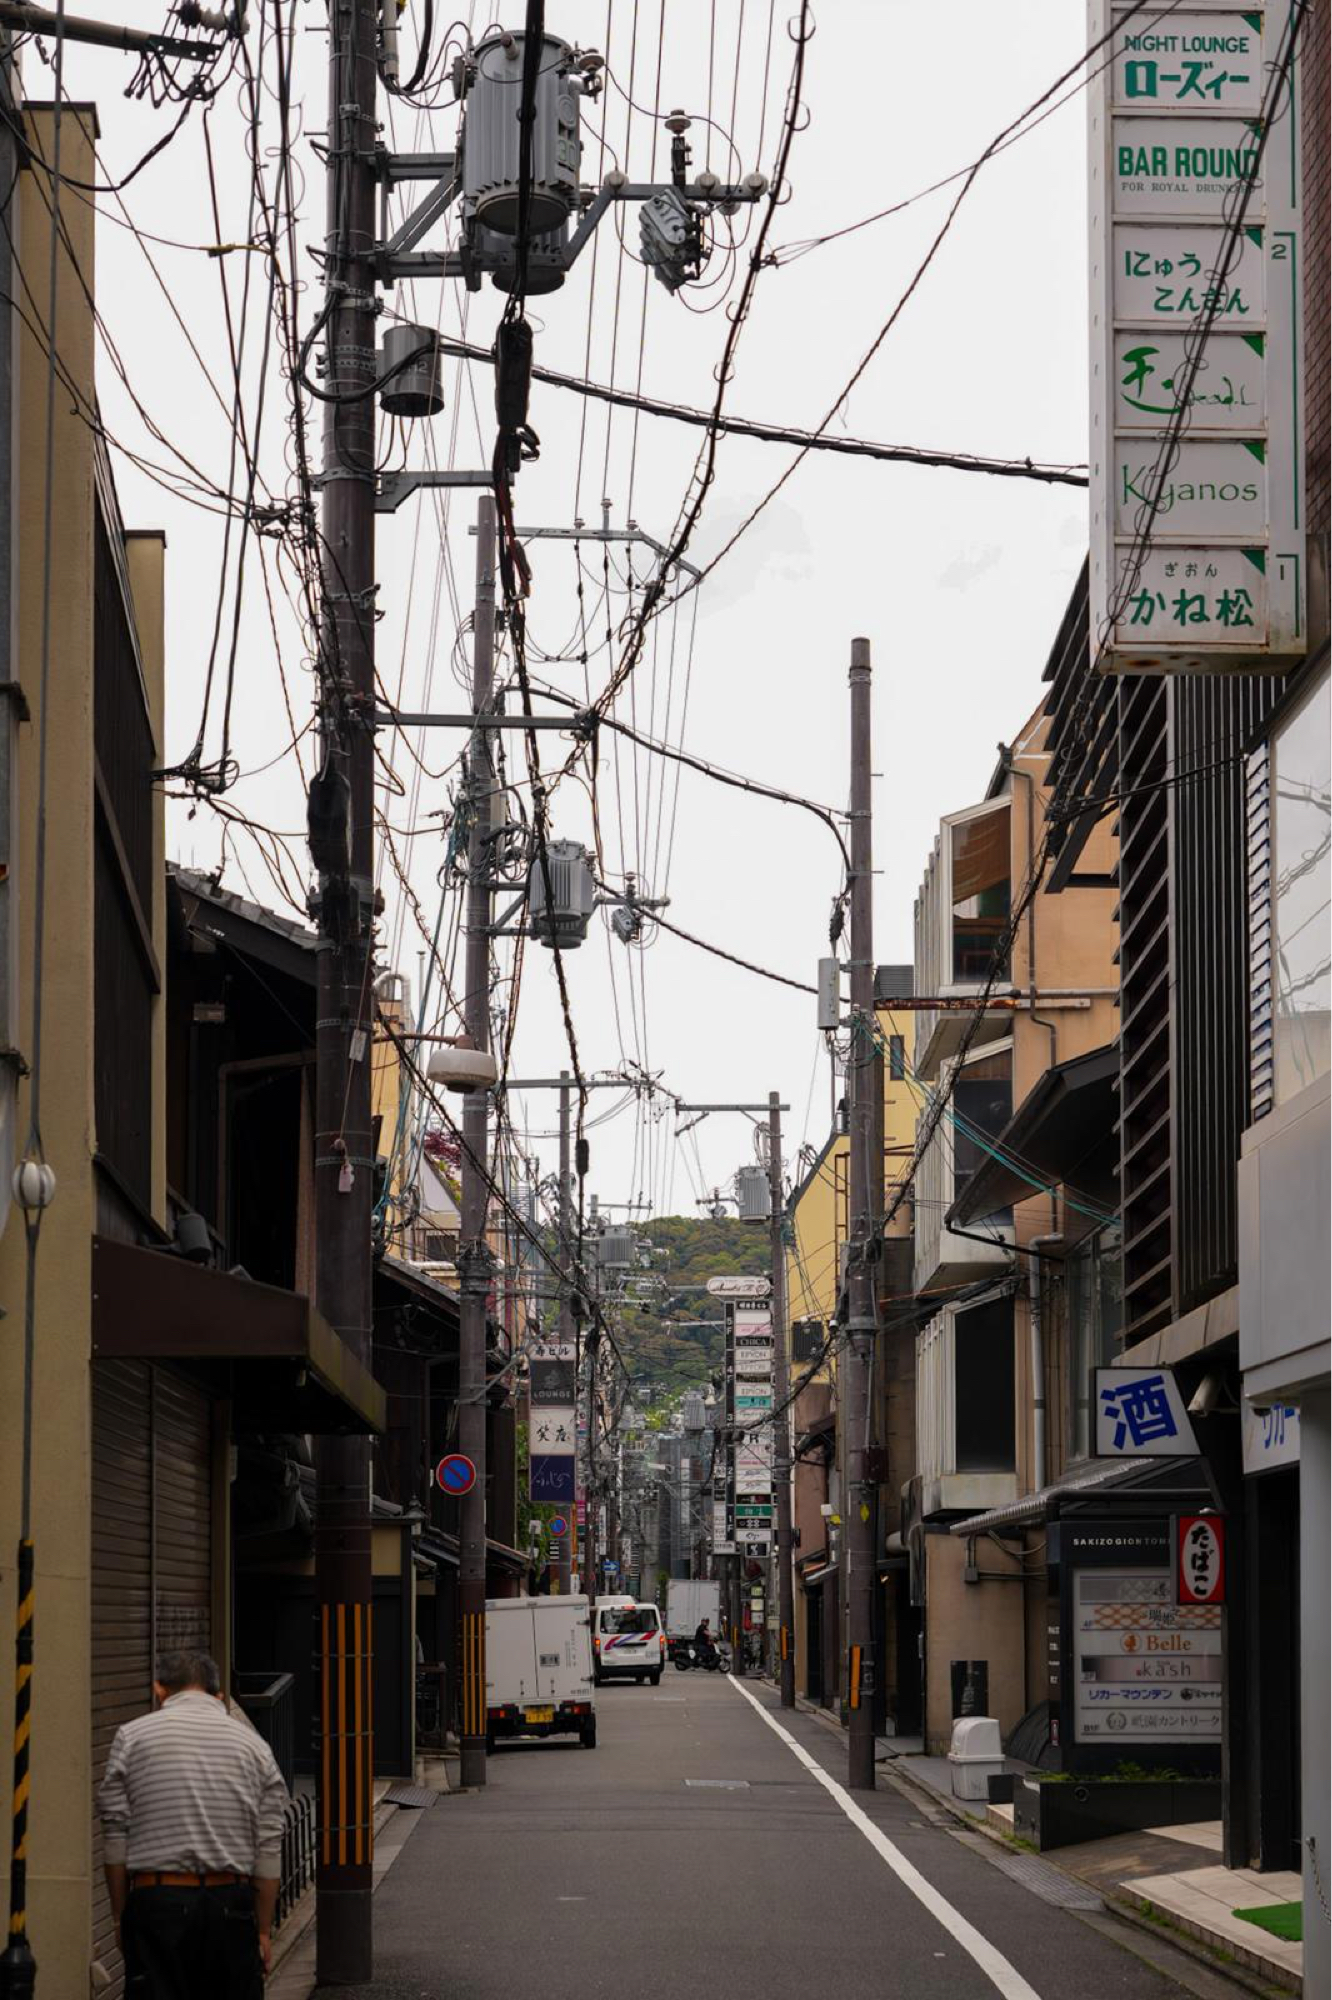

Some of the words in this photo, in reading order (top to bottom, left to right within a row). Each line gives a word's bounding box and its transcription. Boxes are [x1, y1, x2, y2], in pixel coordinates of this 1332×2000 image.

[1124, 36, 1178, 52] NIGHT
[1182, 36, 1249, 53] LOUNGE
[1124, 60, 1249, 99] ローズィー
[1118, 146, 1167, 177] BAR
[1175, 147, 1260, 180] ROUND
[1121, 182, 1144, 192] FOR
[1151, 182, 1189, 193] ROYAL
[1124, 250, 1201, 277] にゅう
[1271, 243, 1287, 260] 2
[1121, 465, 1257, 512] Kyanos
[1164, 563, 1218, 577] ぎおん
[1129, 588, 1254, 626] かね松
[533, 1390, 571, 1398] LOUNGE
[1100, 1375, 1178, 1450] 酒
[1190, 1525, 1216, 1596] たばこ
[1146, 1634, 1192, 1652] Belle
